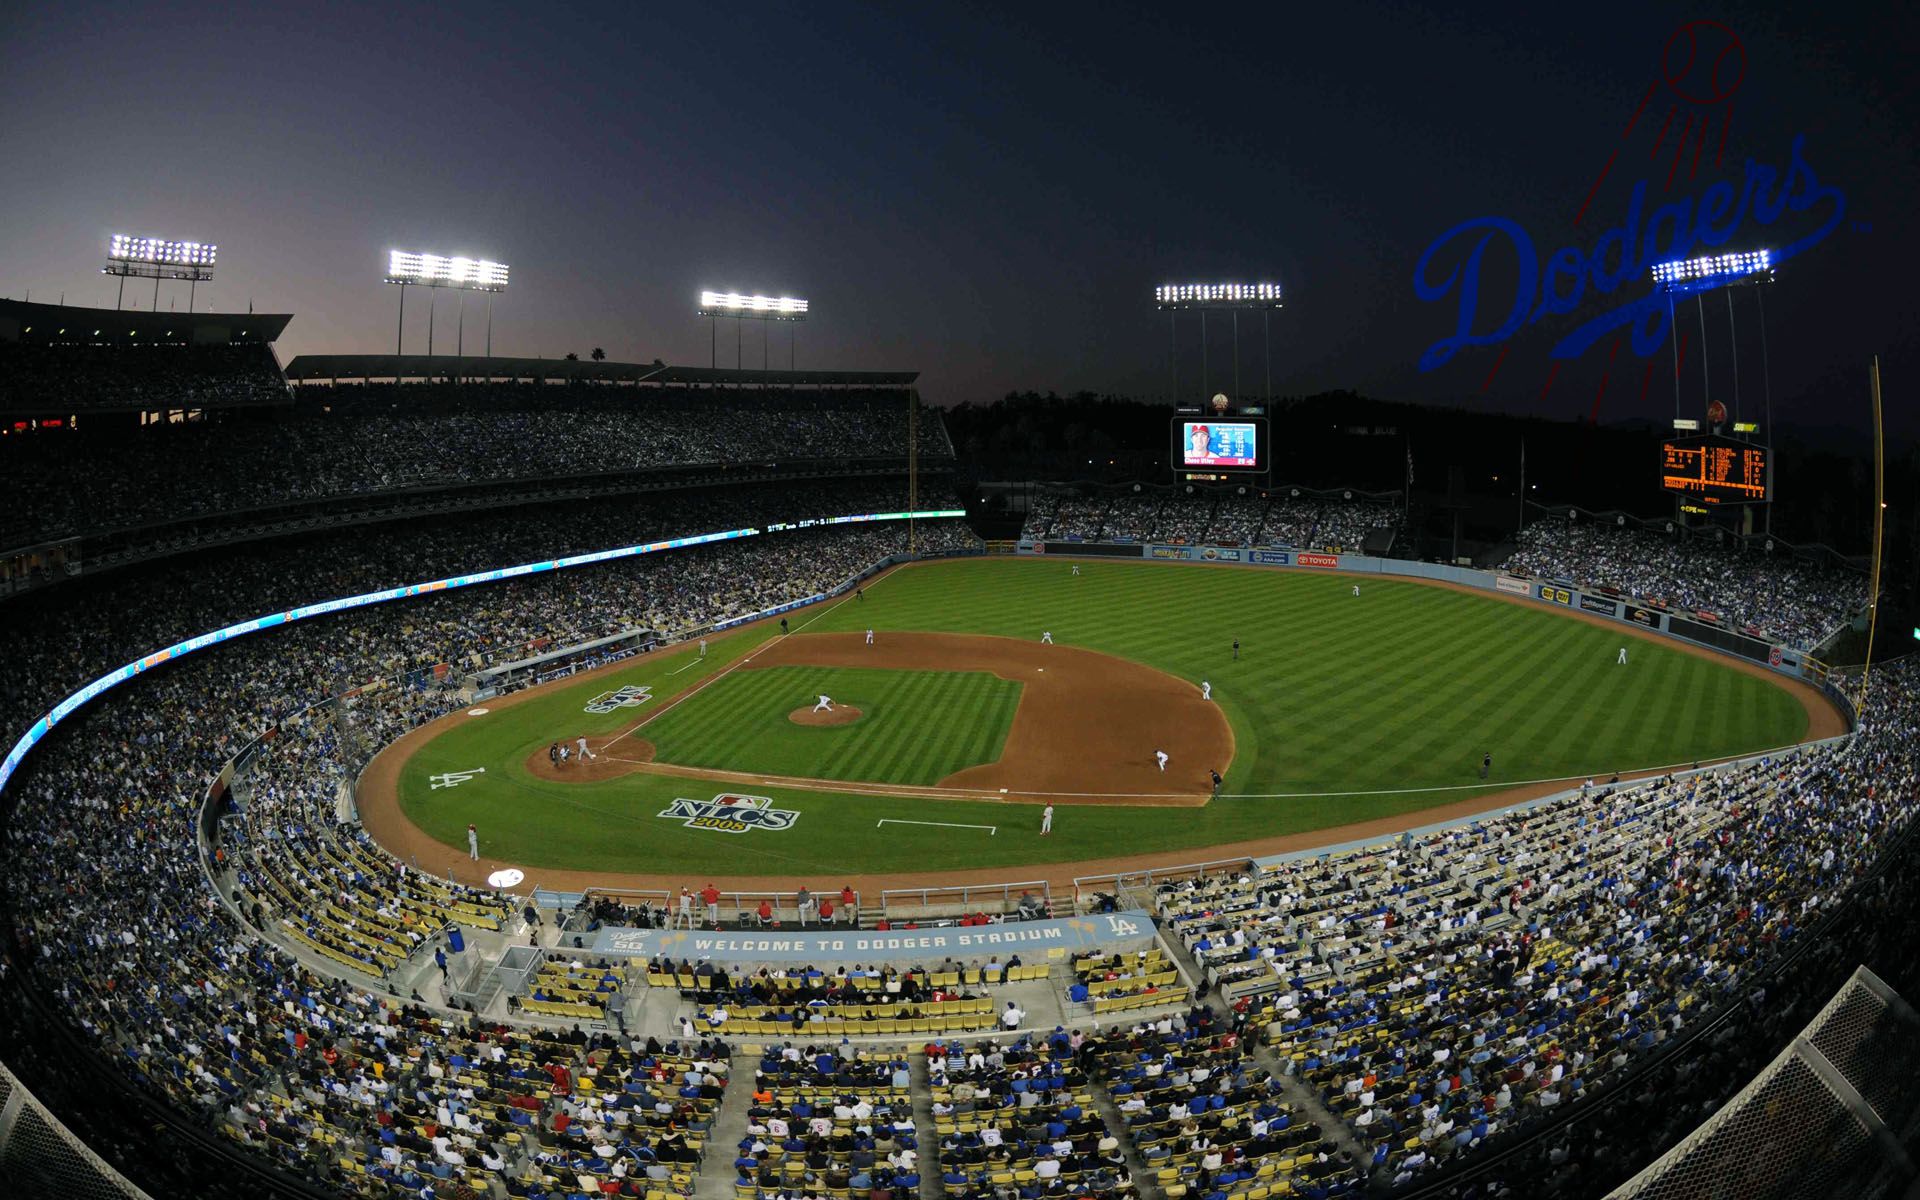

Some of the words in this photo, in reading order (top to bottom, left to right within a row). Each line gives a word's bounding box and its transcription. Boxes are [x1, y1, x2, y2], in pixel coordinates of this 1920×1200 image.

[1309, 557, 1337, 565] TOYOTA
[658, 798, 800, 830] NLCS
[692, 817, 746, 831] 2008
[1106, 915, 1139, 936] LA
[695, 939, 805, 951] WELCOME
[816, 940, 844, 951] TO
[856, 937, 947, 950] DODGER
[958, 927, 1062, 946] STADIUM
